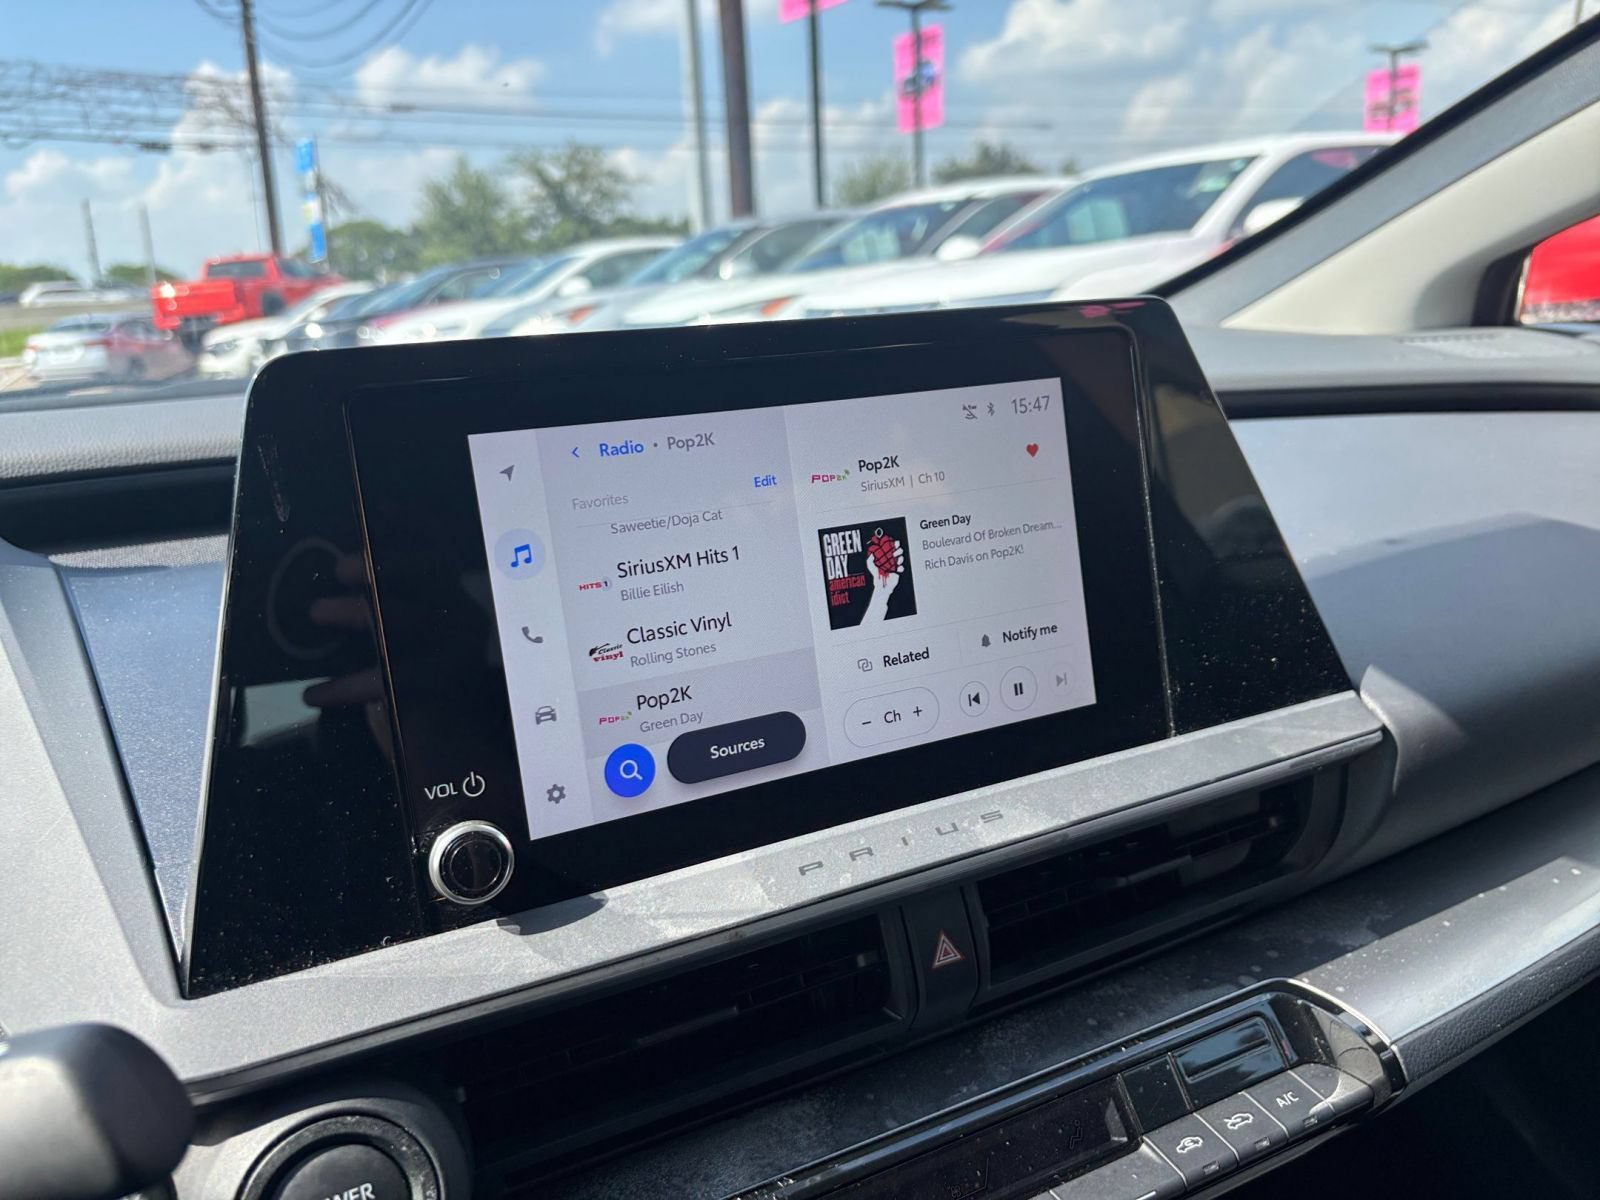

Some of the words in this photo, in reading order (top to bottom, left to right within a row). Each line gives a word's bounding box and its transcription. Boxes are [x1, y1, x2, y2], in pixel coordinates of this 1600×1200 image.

[1011, 395, 1050, 414] 15:47
[600, 440, 644, 457] Radio
[667, 432, 715, 452] Pop2K
[858, 455, 900, 473] Pop2K
[754, 474, 778, 488] Edit
[861, 476, 905, 492] SiriusXM
[918, 473, 932, 484] Ch
[934, 471, 945, 482] 10
[572, 494, 629, 511] Favorites
[610, 513, 700, 535] Saweetie/Doja
[702, 509, 723, 522] Cat
[919, 517, 950, 530] Green
[952, 514, 972, 526] Day
[823, 529, 862, 557] GREEN
[922, 533, 972, 550] Boulevard
[973, 530, 987, 542] Of
[988, 526, 1022, 539] Broken
[616, 552, 692, 579] SiriusXM
[697, 548, 729, 566] Hits
[732, 545, 740, 560] 1
[826, 554, 848, 580] DAY
[924, 557, 946, 570] Rich
[948, 552, 974, 566] Davis
[975, 552, 989, 562] on
[990, 544, 1024, 560] Pop2K!
[579, 581, 602, 591] HITS
[621, 587, 651, 601] Billie
[653, 581, 685, 596] Eilish
[626, 620, 688, 644] Classic
[690, 612, 733, 633] Vinyl
[1002, 626, 1038, 643] Notify
[1039, 623, 1058, 636] me
[593, 651, 624, 662] vinyl
[630, 650, 674, 667] Rolling
[676, 643, 717, 659] Stones
[883, 647, 930, 668] Related
[636, 684, 693, 711] Pop2K
[639, 716, 678, 734] Green
[680, 710, 704, 726] Day
[883, 709, 902, 724] Ch
[710, 736, 766, 759] Sources
[424, 782, 458, 800] VOL
[798, 809, 1004, 876] PRIUS
[1276, 1090, 1300, 1109] A/C
[324, 1182, 376, 1200] WER
